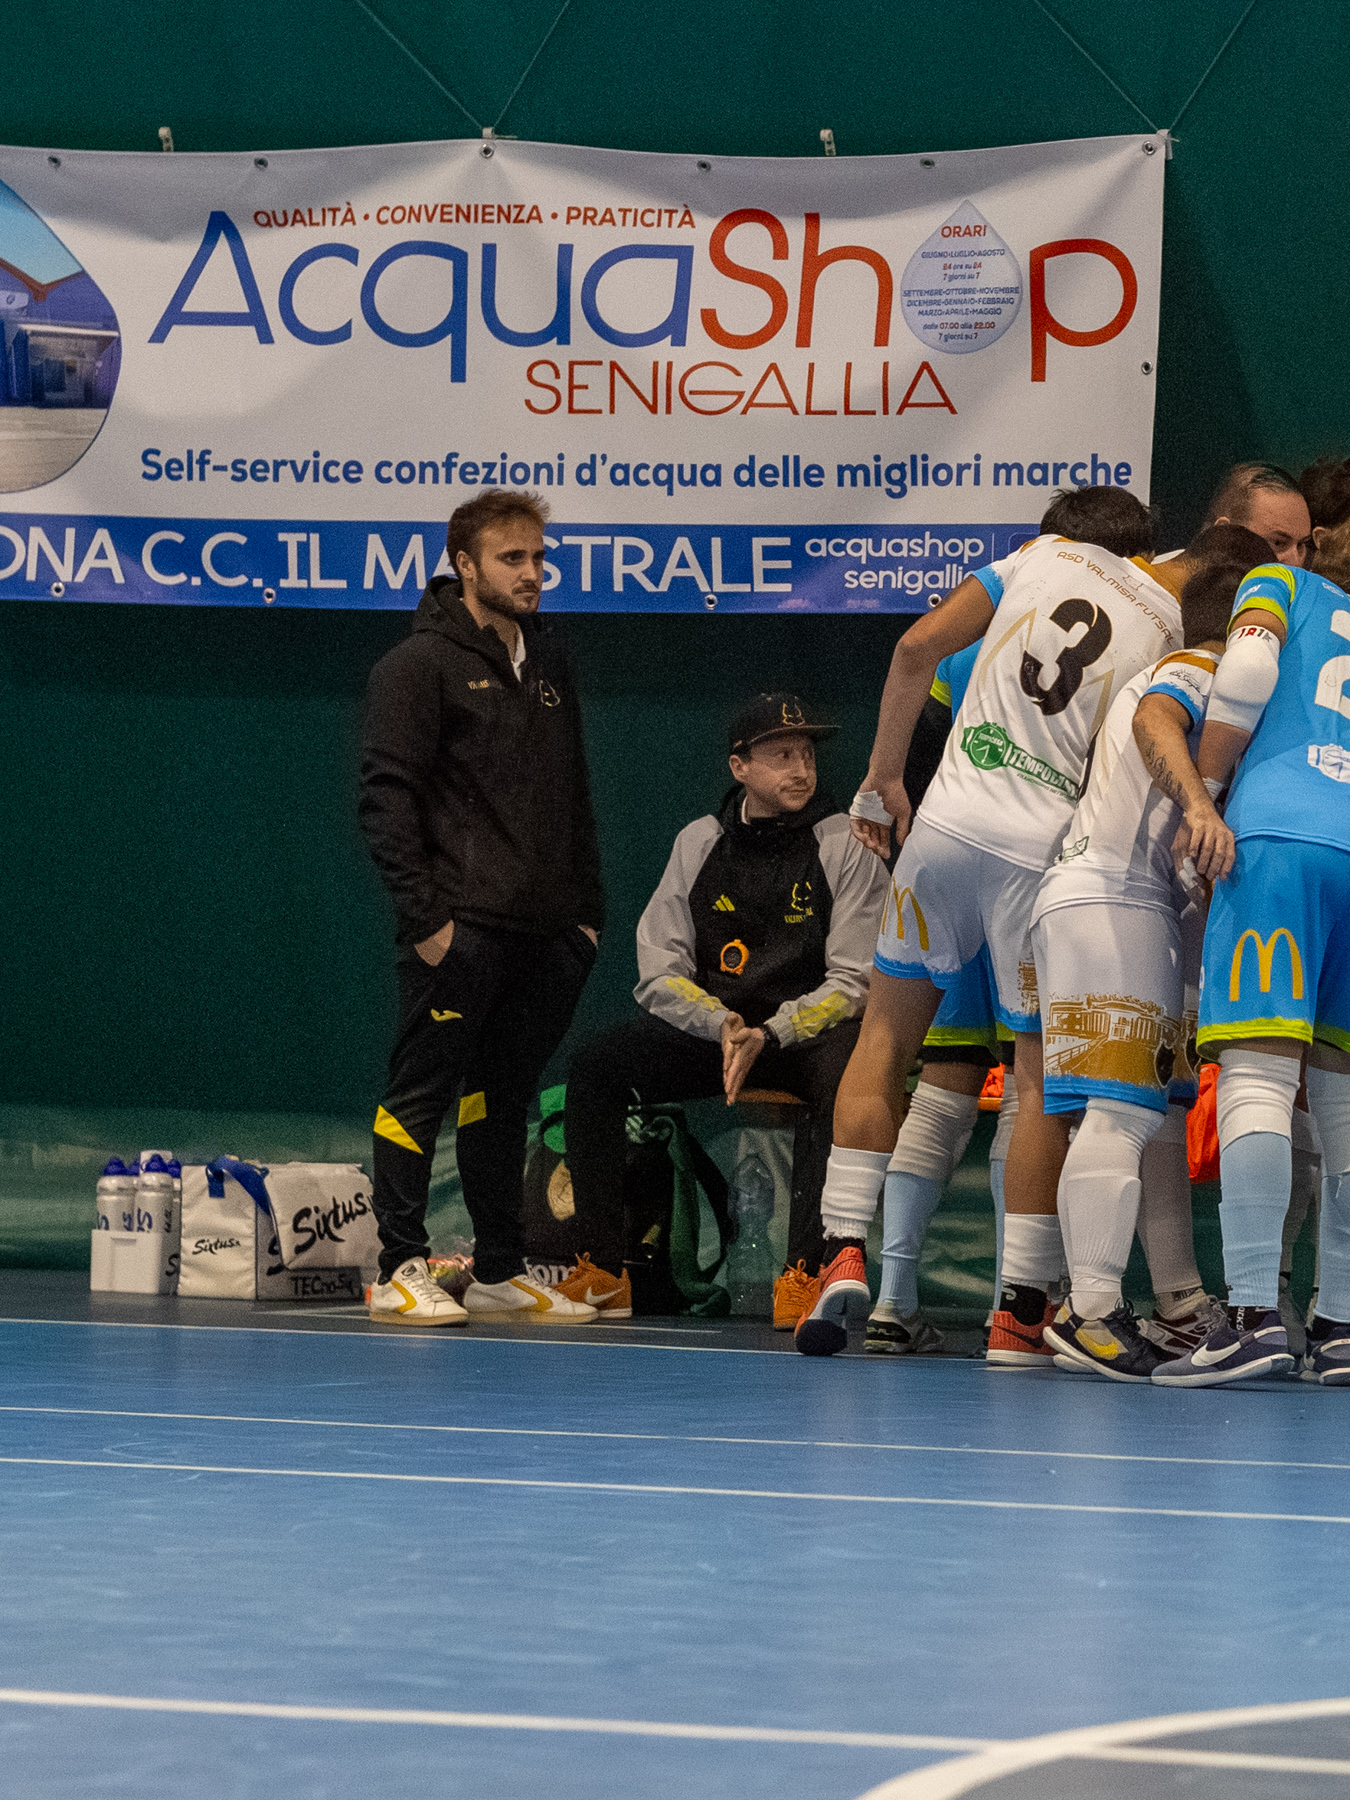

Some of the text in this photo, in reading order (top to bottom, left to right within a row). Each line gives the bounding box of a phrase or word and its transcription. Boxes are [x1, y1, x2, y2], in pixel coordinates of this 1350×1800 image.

[253, 202, 696, 229] QUALITÀ CONVENIENZA PRATICITÀ
[941, 225, 987, 238] ORARI
[524, 358, 958, 416] SENIGALLIA
[140, 448, 364, 484] Self-service
[374, 452, 565, 487] confezioni
[733, 454, 825, 488] delle
[837, 453, 982, 500] migliori
[992, 453, 1133, 488] marche
[805, 531, 985, 564] acquashop
[1086, 559, 1137, 603] VALMISA
[1136, 602, 1177, 647] FUTSAL
[1019, 598, 1113, 717] 3
[292, 1192, 369, 1255] Sixtus
